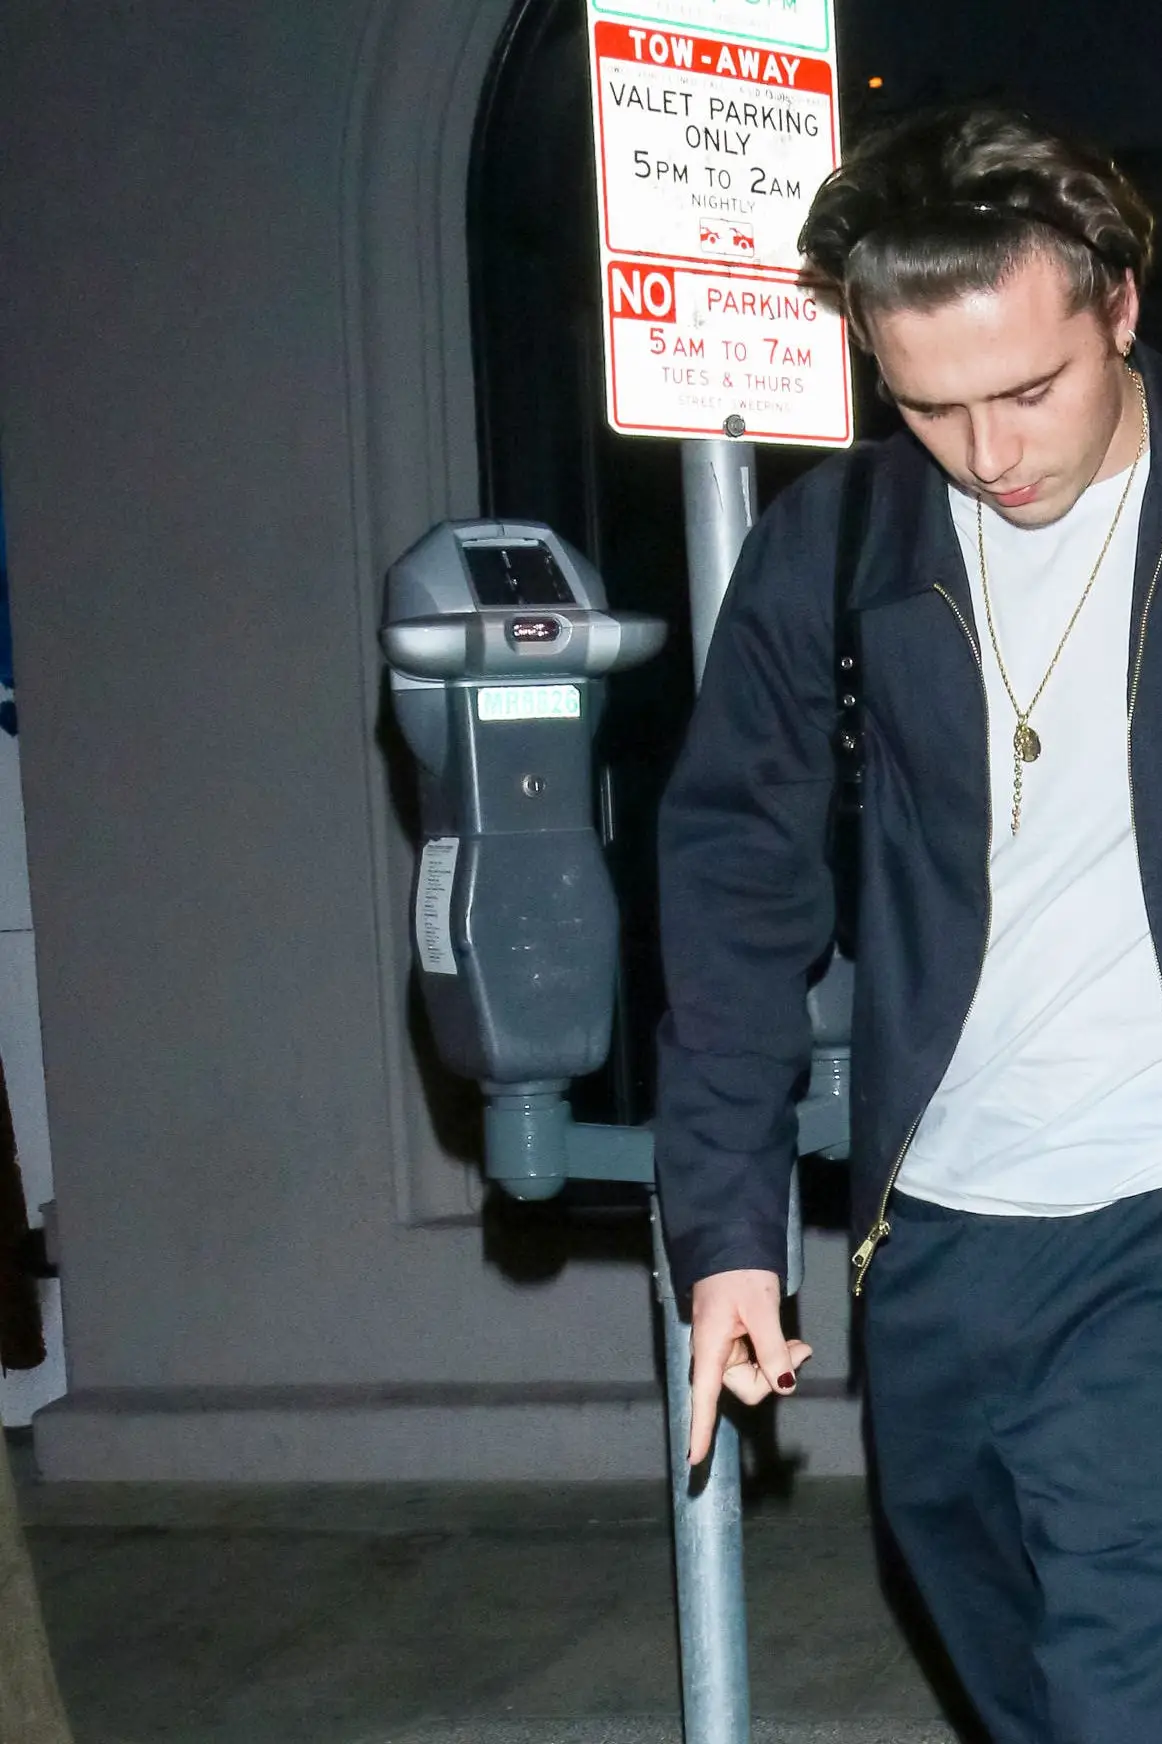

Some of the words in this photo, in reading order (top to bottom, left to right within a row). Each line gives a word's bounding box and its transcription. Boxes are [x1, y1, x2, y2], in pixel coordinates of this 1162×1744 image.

[628, 29, 801, 86] TOW-AWAY
[609, 81, 692, 117] VALET
[709, 97, 819, 137] PARKING
[685, 125, 751, 156] ONLY
[633, 150, 689, 185] 5PM
[705, 166, 731, 190] TO
[750, 167, 801, 200] 2AM
[691, 193, 755, 214] NIGHTLY
[611, 267, 673, 318] NO
[707, 287, 818, 323] PARKING
[649, 328, 705, 359] 5AM
[722, 340, 748, 362] TO
[763, 338, 813, 368] 7AM
[661, 366, 710, 387] TUES
[722, 371, 734, 388] &
[744, 373, 805, 395] THURS
